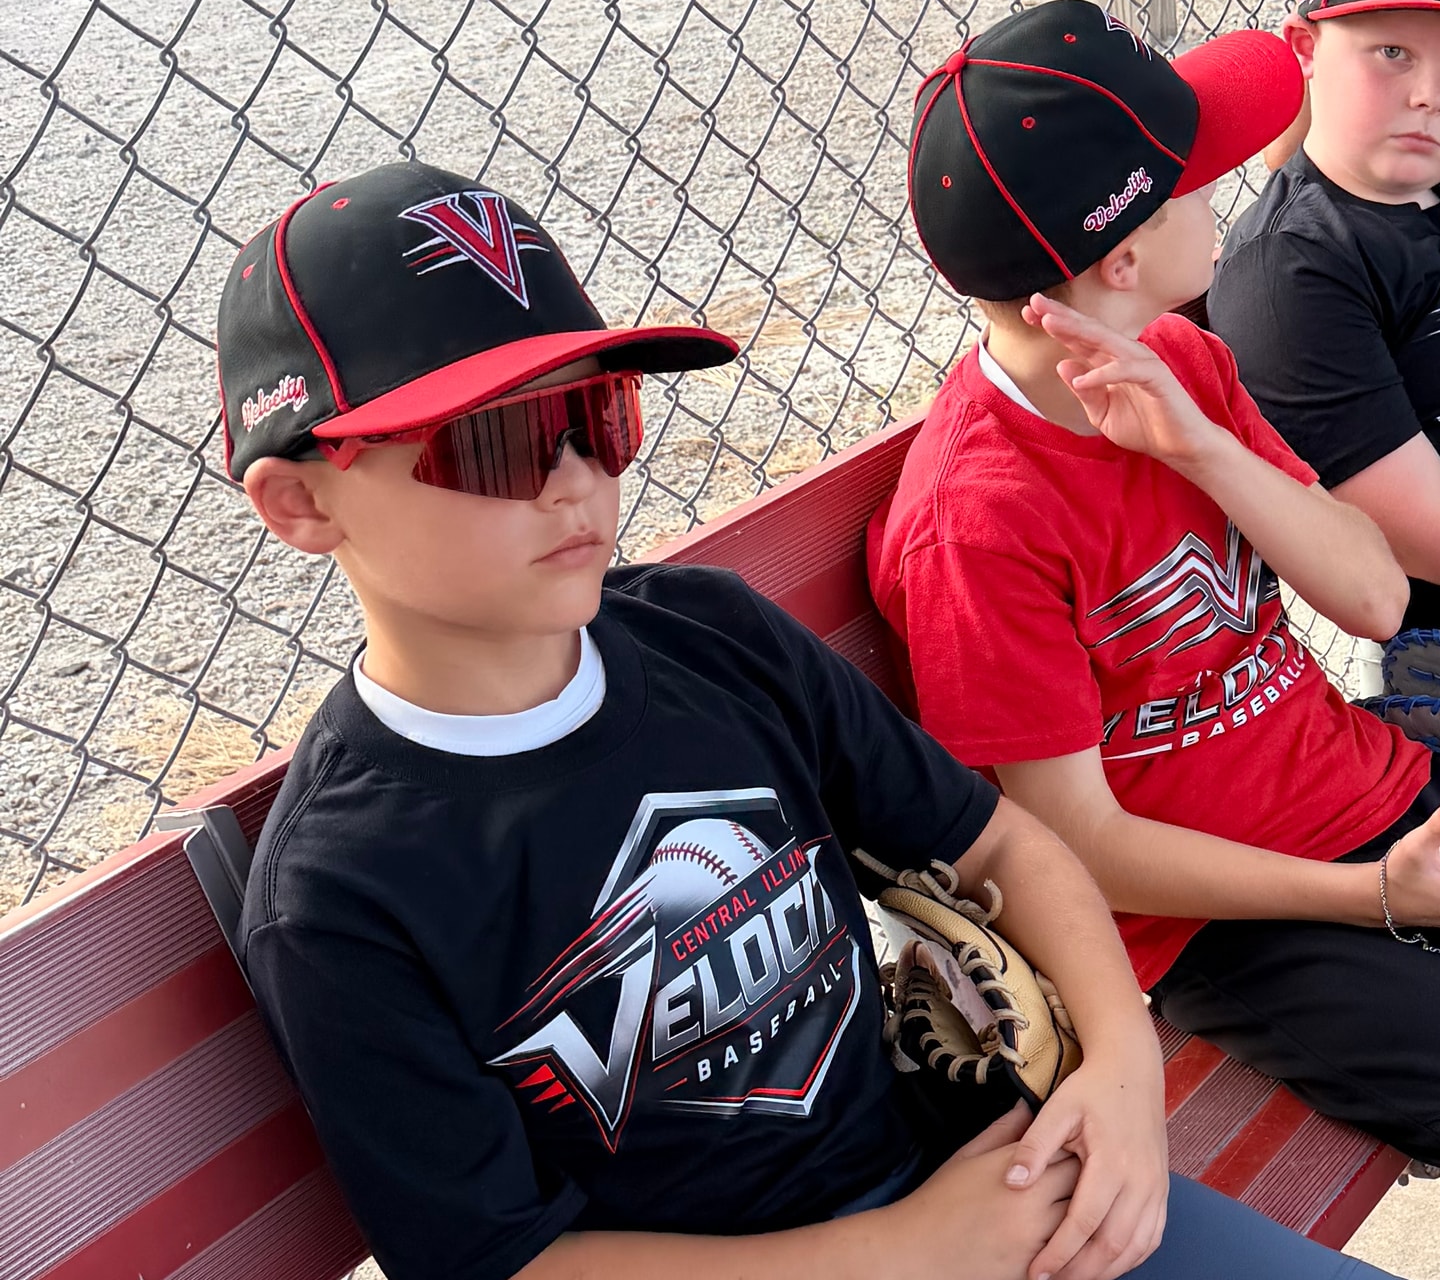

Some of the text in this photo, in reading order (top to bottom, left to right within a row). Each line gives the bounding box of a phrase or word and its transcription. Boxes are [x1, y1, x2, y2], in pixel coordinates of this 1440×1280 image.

[1084, 167, 1153, 231] Velocity
[400, 192, 529, 310] V
[242, 375, 308, 432] Velocity
[1181, 657, 1306, 748] BASEBALL
[671, 846, 806, 962] CENTRAL ILLIN
[697, 963, 842, 1083] BASEBALL
